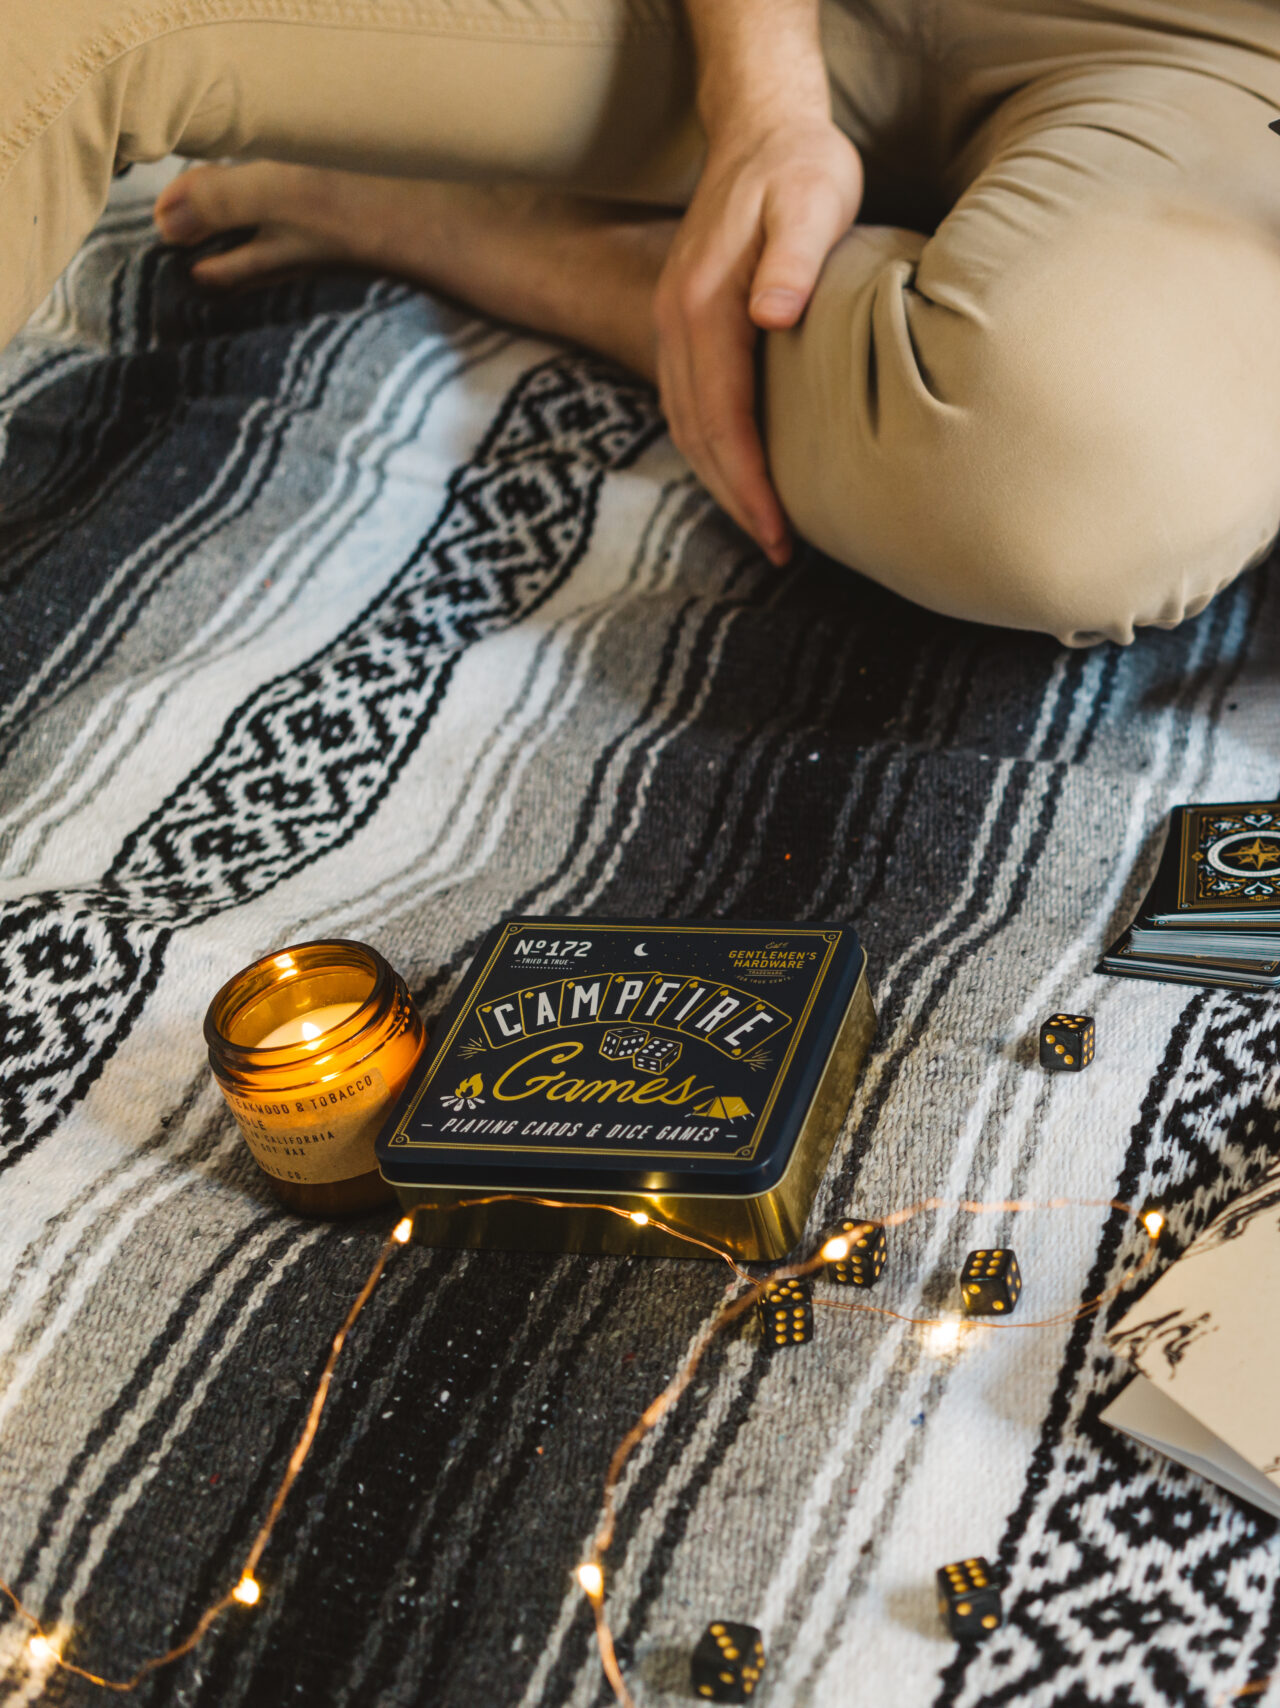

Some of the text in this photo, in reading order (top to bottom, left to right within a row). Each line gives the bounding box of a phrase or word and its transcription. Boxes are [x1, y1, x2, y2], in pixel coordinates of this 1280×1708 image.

[521, 957, 542, 965] TRIED
[550, 958, 569, 966] TRUE
[728, 950, 817, 961] GENTLEMEN'S
[733, 959, 806, 969] HARDWARE
[492, 980, 774, 1047] CAMPFIRE
[492, 1041, 715, 1105] Games
[295, 1102, 304, 1112] &
[310, 1075, 373, 1110] TOBACCO
[440, 1118, 720, 1142] PLAYING CARDS & DICE GAMES
[264, 1131, 335, 1146] CALIFORNIA
[283, 1148, 306, 1156] WAX
